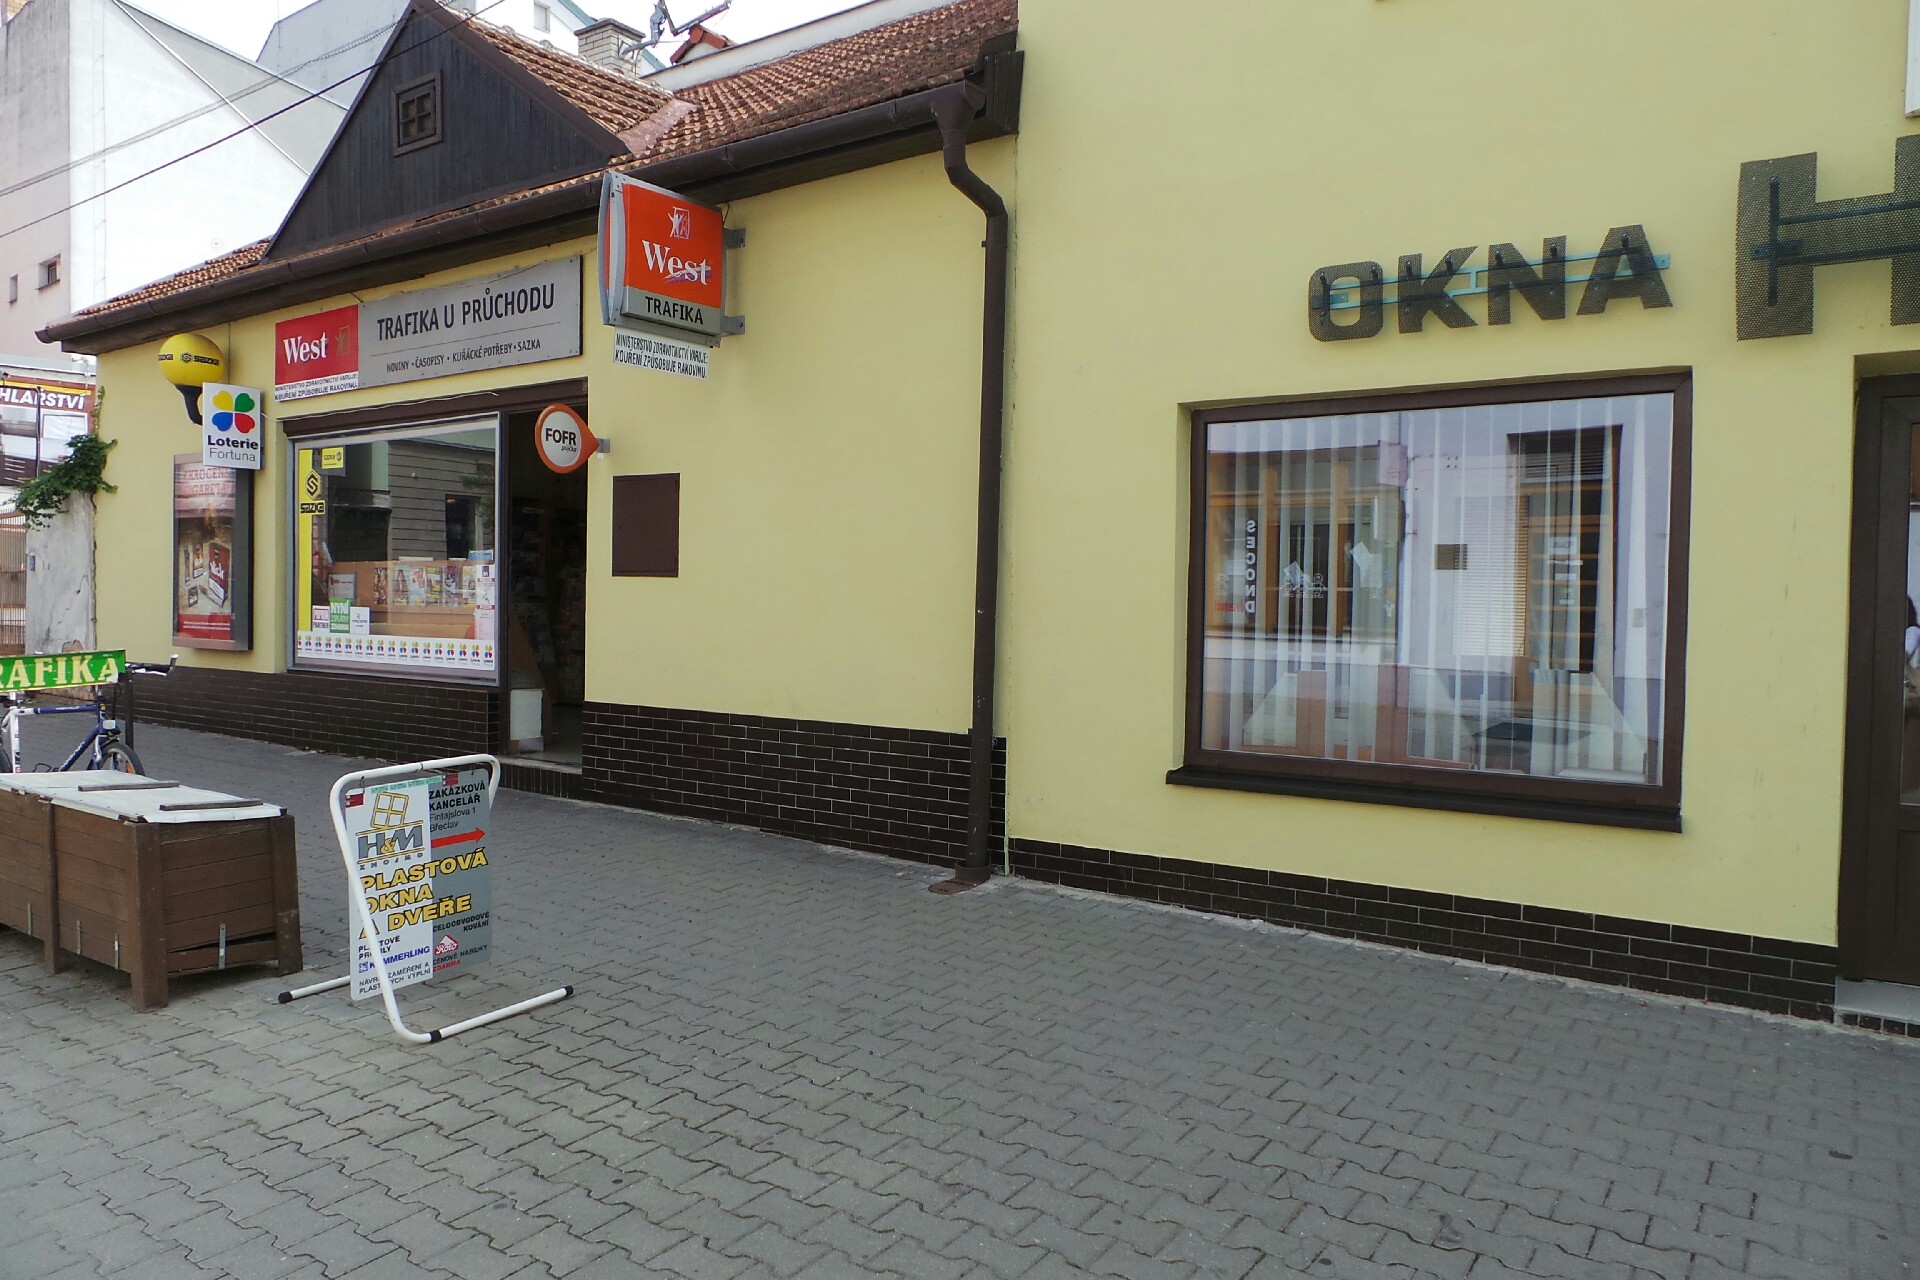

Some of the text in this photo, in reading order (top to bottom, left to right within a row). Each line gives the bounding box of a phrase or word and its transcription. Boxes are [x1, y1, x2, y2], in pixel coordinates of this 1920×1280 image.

[641, 239, 713, 286] West
[1308, 224, 1673, 342] OKNA
[377, 283, 555, 341] TRAFIKA U PRŮCHODU
[645, 296, 704, 325] TRAFIKA
[283, 331, 327, 364] West
[616, 333, 653, 353] MINISTERSTVO
[386, 338, 541, 373] NOVINY ČASOPISY KUŘÁCKÉ POTŘEBY SAZKA
[615, 348, 643, 366] KOUŘENÍ
[207, 434, 259, 450] Loterie
[545, 427, 577, 446] FOFR
[209, 447, 257, 461] Fortuna
[429, 780, 486, 800] ZAKÁZKOVÁ
[429, 793, 481, 811] KANCELÁŘ
[472, 806, 476, 814] 1
[430, 820, 459, 832] Břeclav
[357, 824, 424, 860] H&M
[360, 846, 489, 894] PLASTOVÁ
[388, 893, 472, 932] DVEŘE
[369, 946, 431, 970] KMMERLING
[433, 959, 461, 973] ZDARMA
